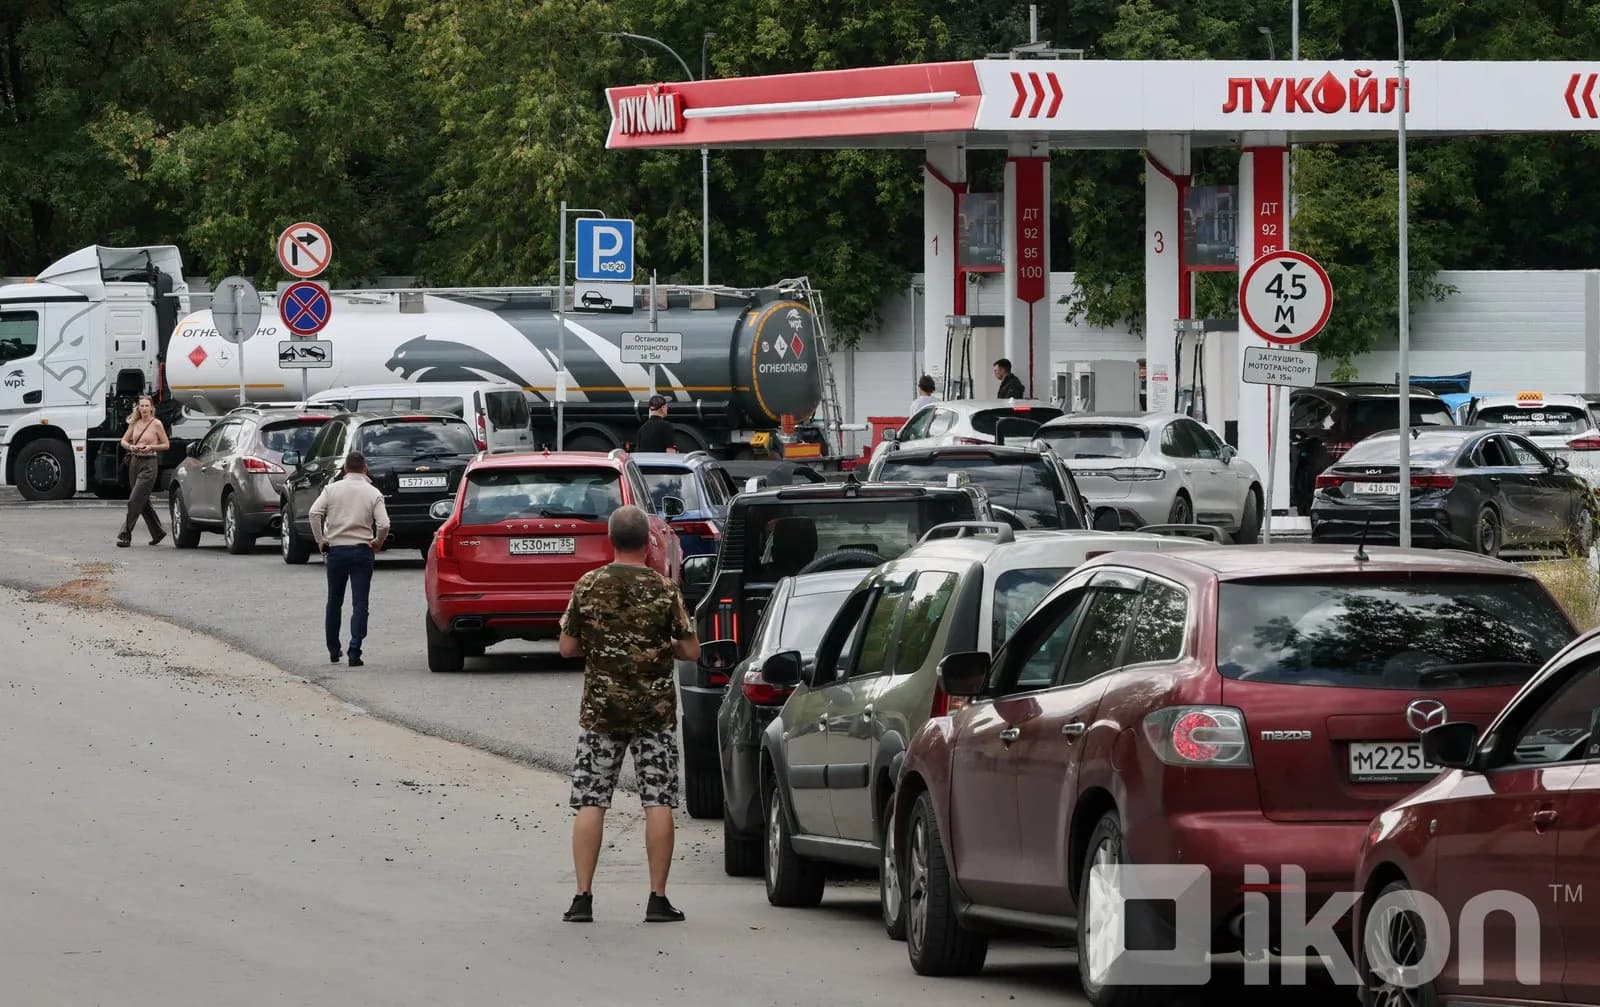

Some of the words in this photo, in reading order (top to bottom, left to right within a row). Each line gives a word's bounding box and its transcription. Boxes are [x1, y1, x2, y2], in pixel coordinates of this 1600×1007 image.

[1222, 69, 1409, 113] ЛУКОЙЛ
[1023, 208, 1039, 220] ДТ
[1260, 202, 1278, 216] ДТ
[1024, 228, 1038, 239] 92
[1262, 223, 1277, 236] 92
[932, 234, 938, 256] 1
[1154, 230, 1164, 254] 3
[593, 226, 623, 272] P
[1024, 247, 1038, 258] 95
[1020, 266, 1042, 278] 100
[1265, 273, 1307, 303] 4,5
[1257, 353, 1304, 364] ЗАГЛУШИТЬ
[759, 362, 808, 374] ОГНЕОПАСНО
[1248, 361, 1312, 374] МОТОТРАНСПОРТ
[4, 378, 25, 389] wpt
[560, 539, 571, 547] 35
